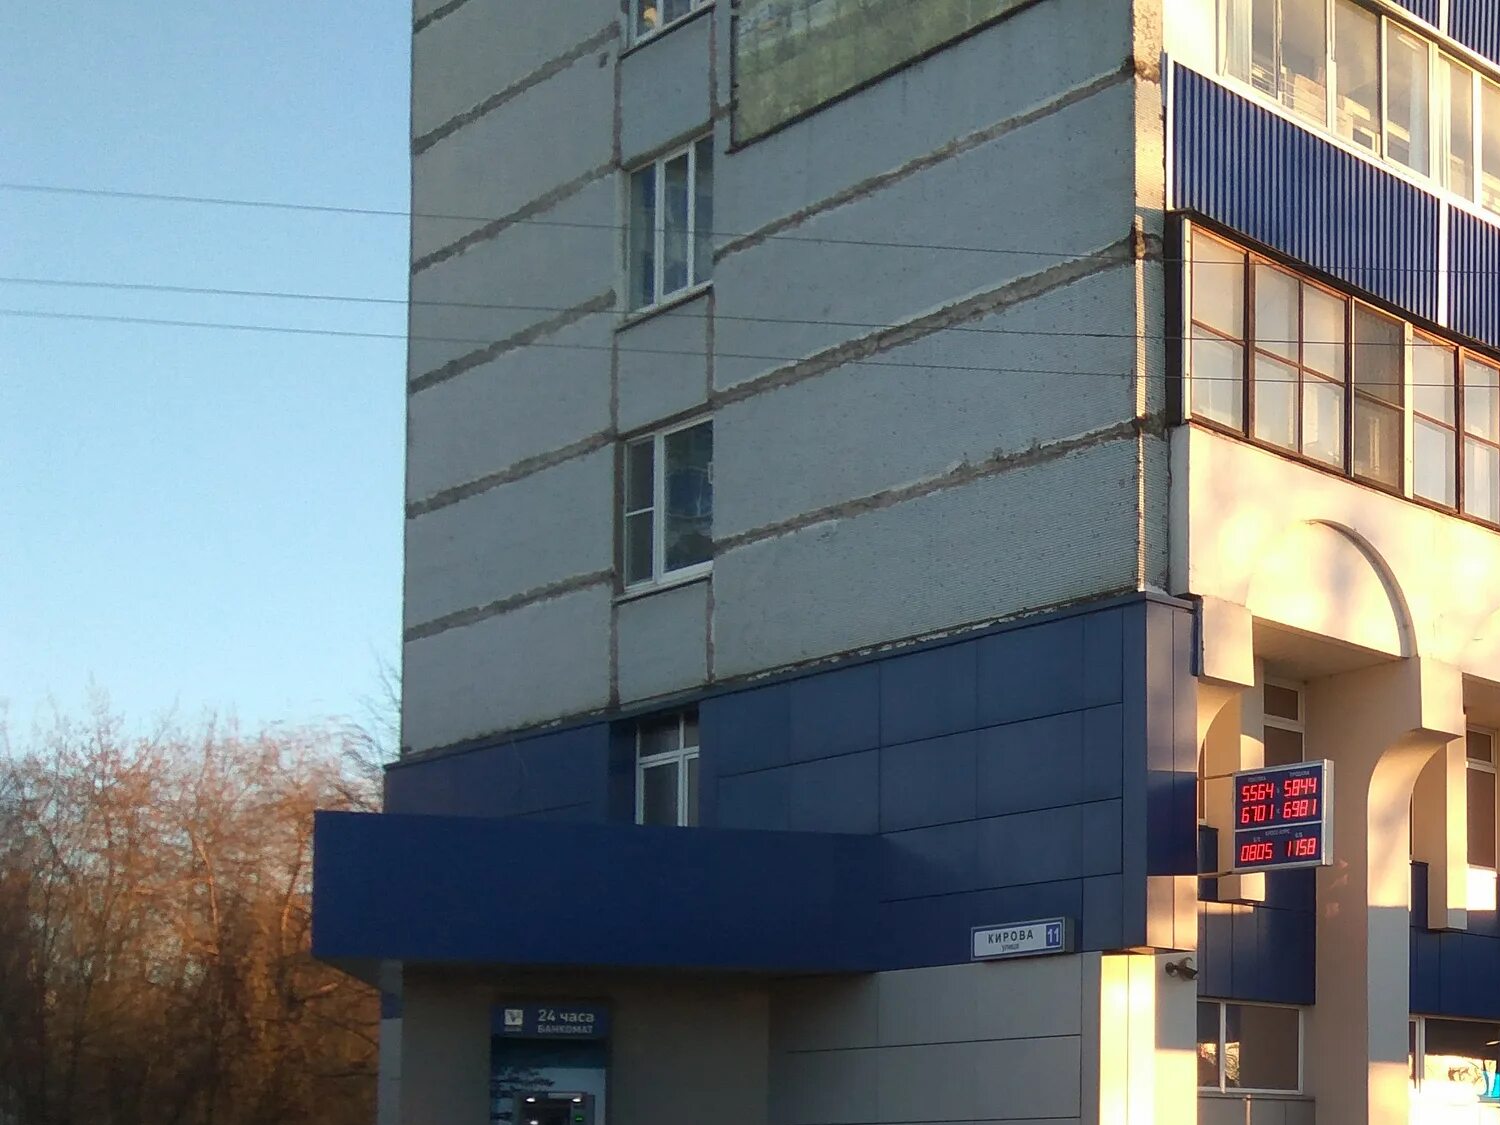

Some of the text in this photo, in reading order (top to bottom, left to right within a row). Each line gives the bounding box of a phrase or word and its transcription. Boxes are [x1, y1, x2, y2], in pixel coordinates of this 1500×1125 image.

[1241, 777, 1317, 802] 5564 5844
[1241, 799, 1317, 824] 6701 6981
[1240, 837, 1317, 862] 0805 1158
[988, 929, 1034, 945] КИРОВА
[1047, 927, 1059, 943] 11
[538, 1009, 595, 1023] 24 часа
[537, 1024, 593, 1034] БАНКОМАТ
